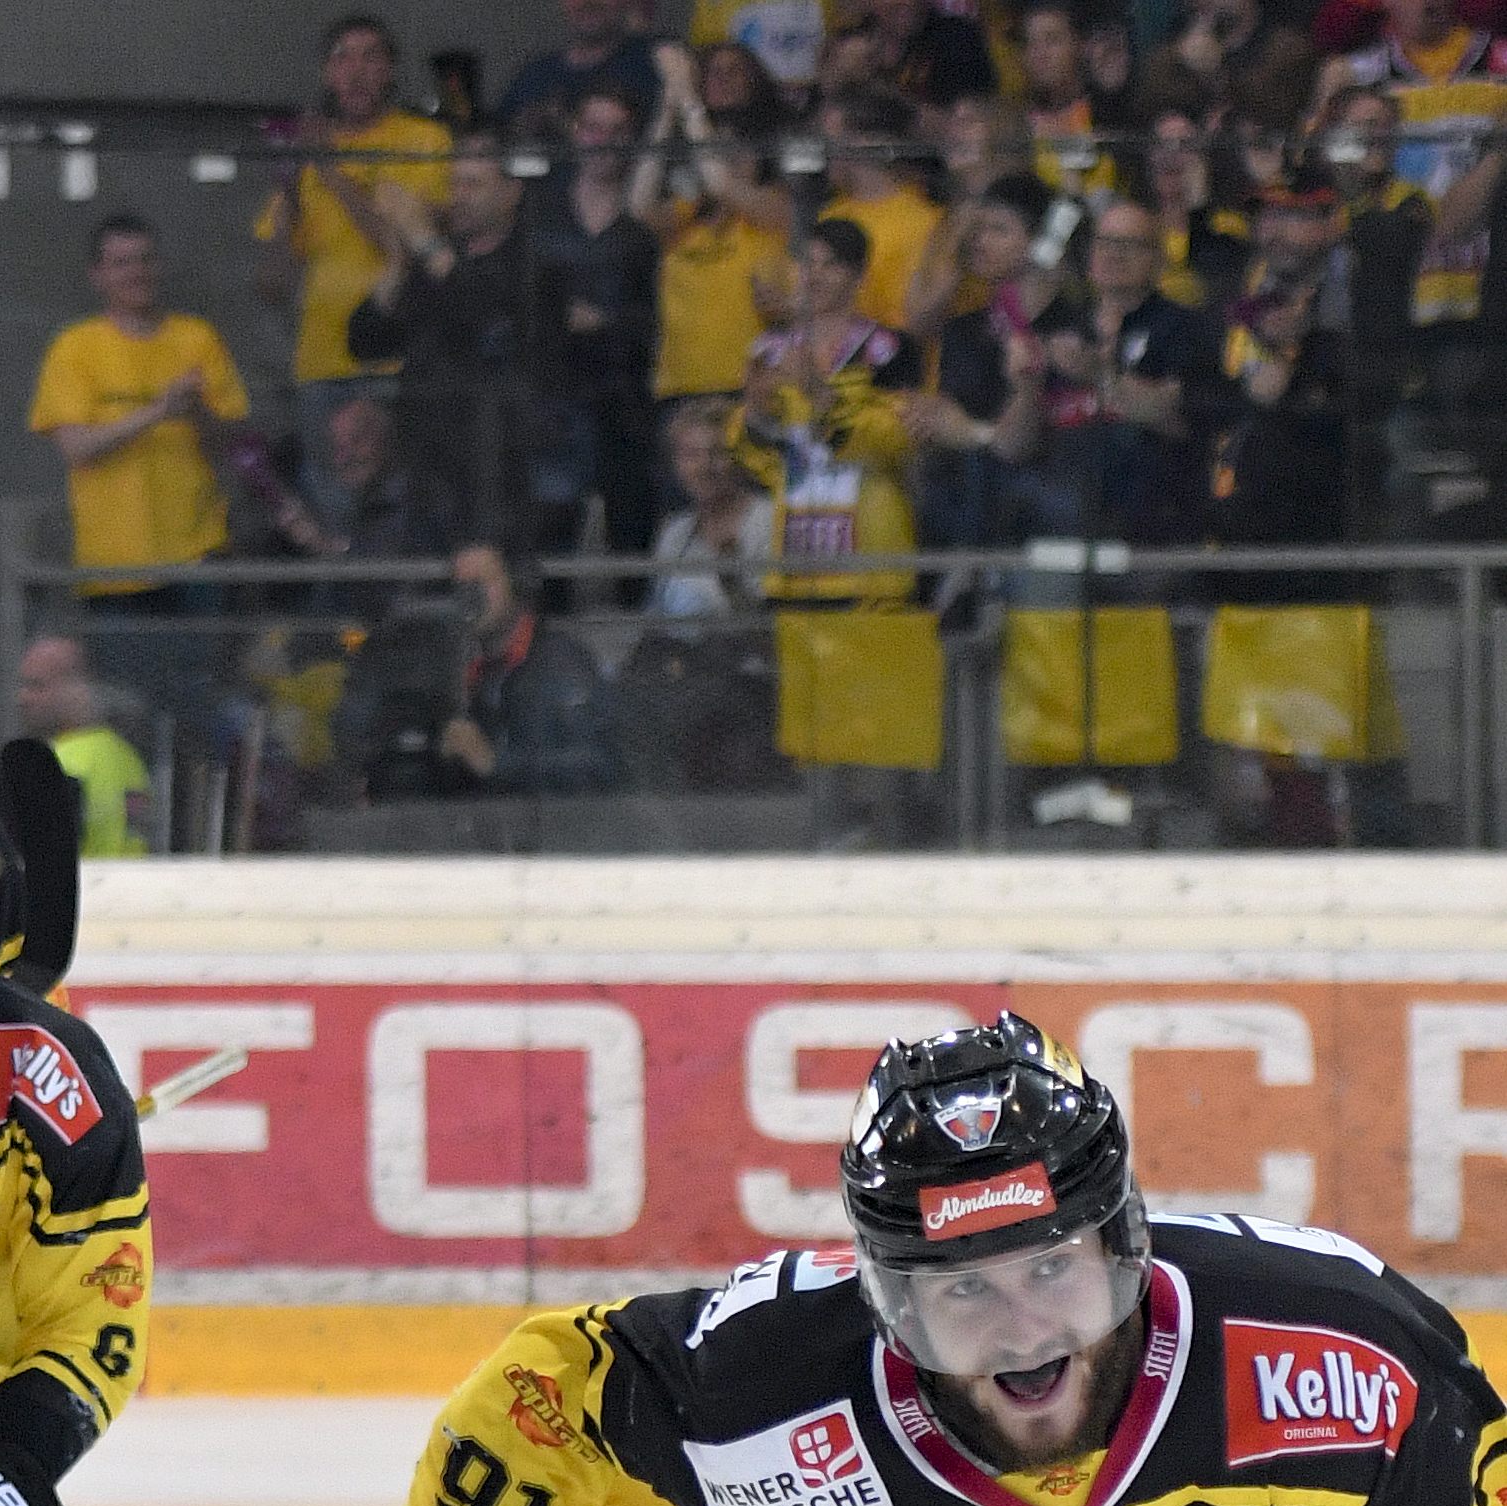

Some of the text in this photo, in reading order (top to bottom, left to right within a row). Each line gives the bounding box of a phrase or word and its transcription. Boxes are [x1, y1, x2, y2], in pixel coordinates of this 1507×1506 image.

[926, 1181, 1045, 1230] Almdudler
[91, 1322, 135, 1378] 6
[1145, 1330, 1178, 1382] STEFFL
[1254, 1350, 1402, 1435] Kelly's
[1283, 1425, 1339, 1441] ORIGINAL
[704, 1471, 803, 1506] WIENER
